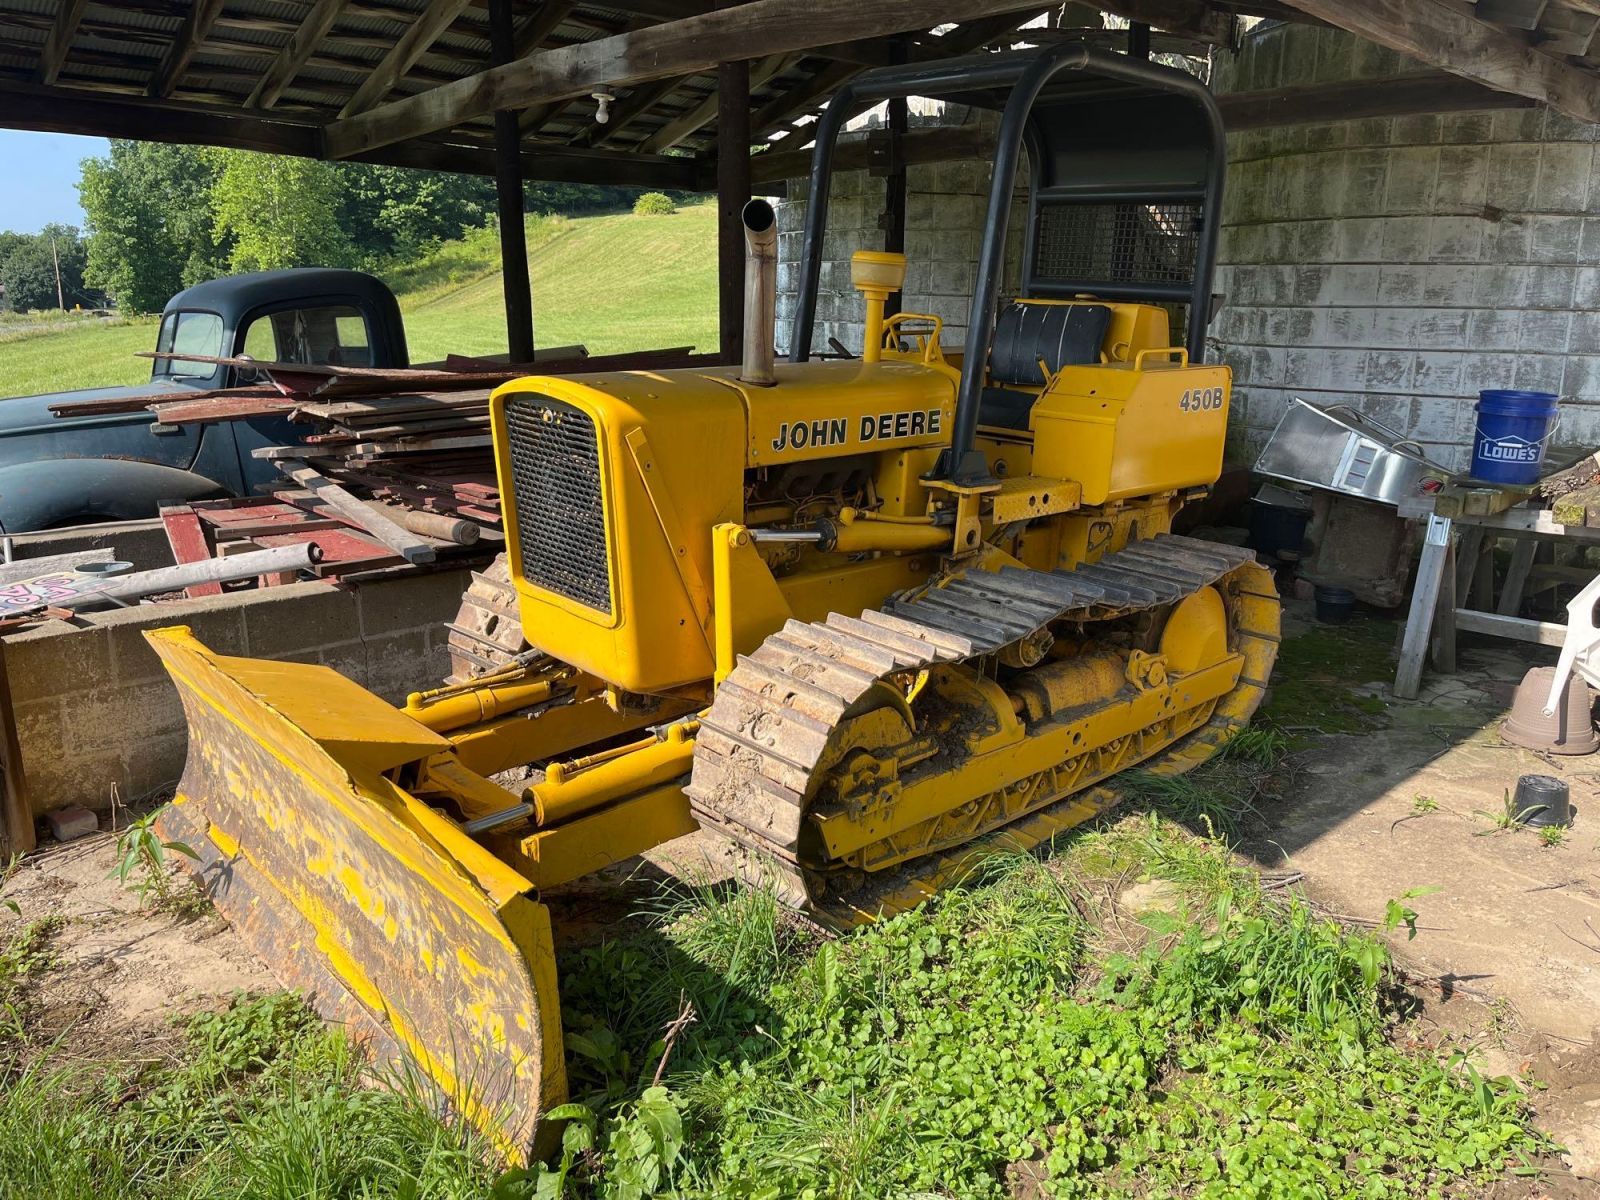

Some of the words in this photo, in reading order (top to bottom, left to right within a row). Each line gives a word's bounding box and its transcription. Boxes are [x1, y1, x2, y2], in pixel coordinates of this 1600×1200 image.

[1179, 387, 1223, 412] 450B
[772, 418, 847, 452] JOHN
[859, 408, 942, 442] DEERE
[1483, 443, 1537, 461] LOWE'S
